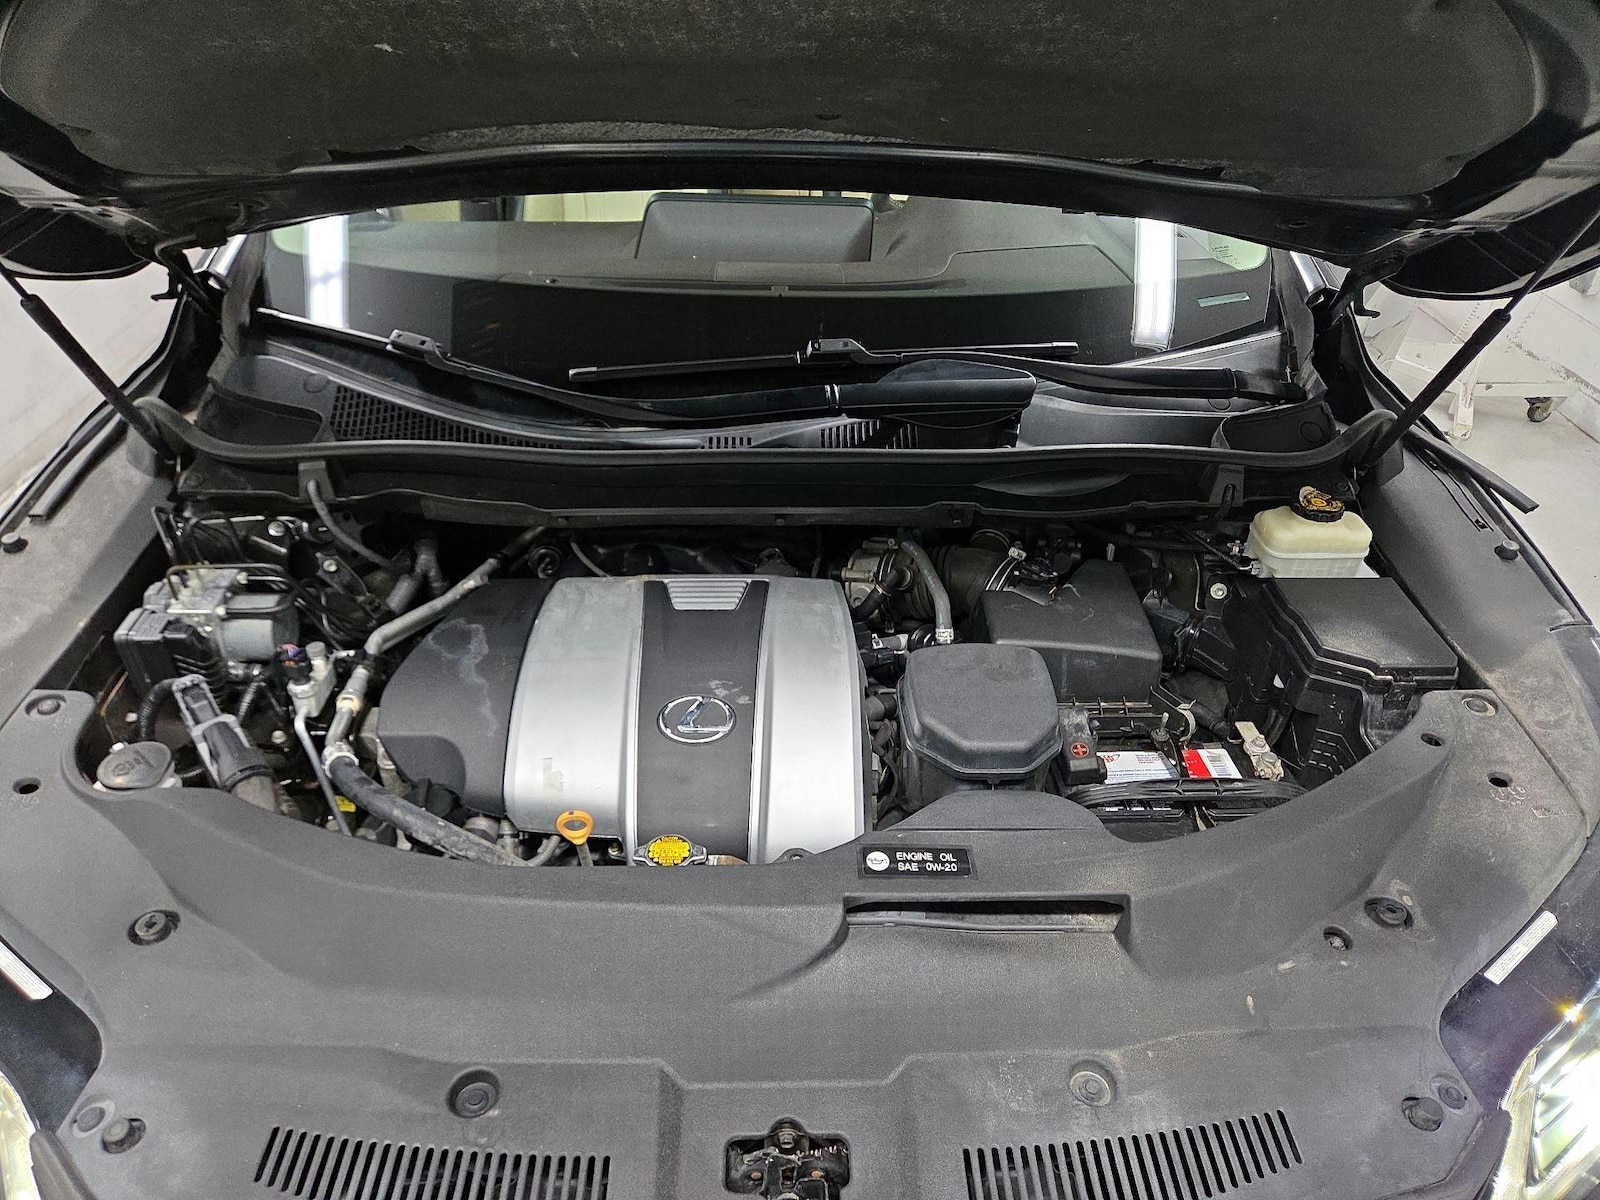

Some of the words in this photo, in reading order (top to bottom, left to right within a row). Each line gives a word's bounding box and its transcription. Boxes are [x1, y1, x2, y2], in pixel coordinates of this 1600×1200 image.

[896, 852, 933, 861] ENGINE
[939, 853, 957, 862] OIL
[897, 862, 919, 871] SAE
[926, 863, 958, 872] 0W-20
